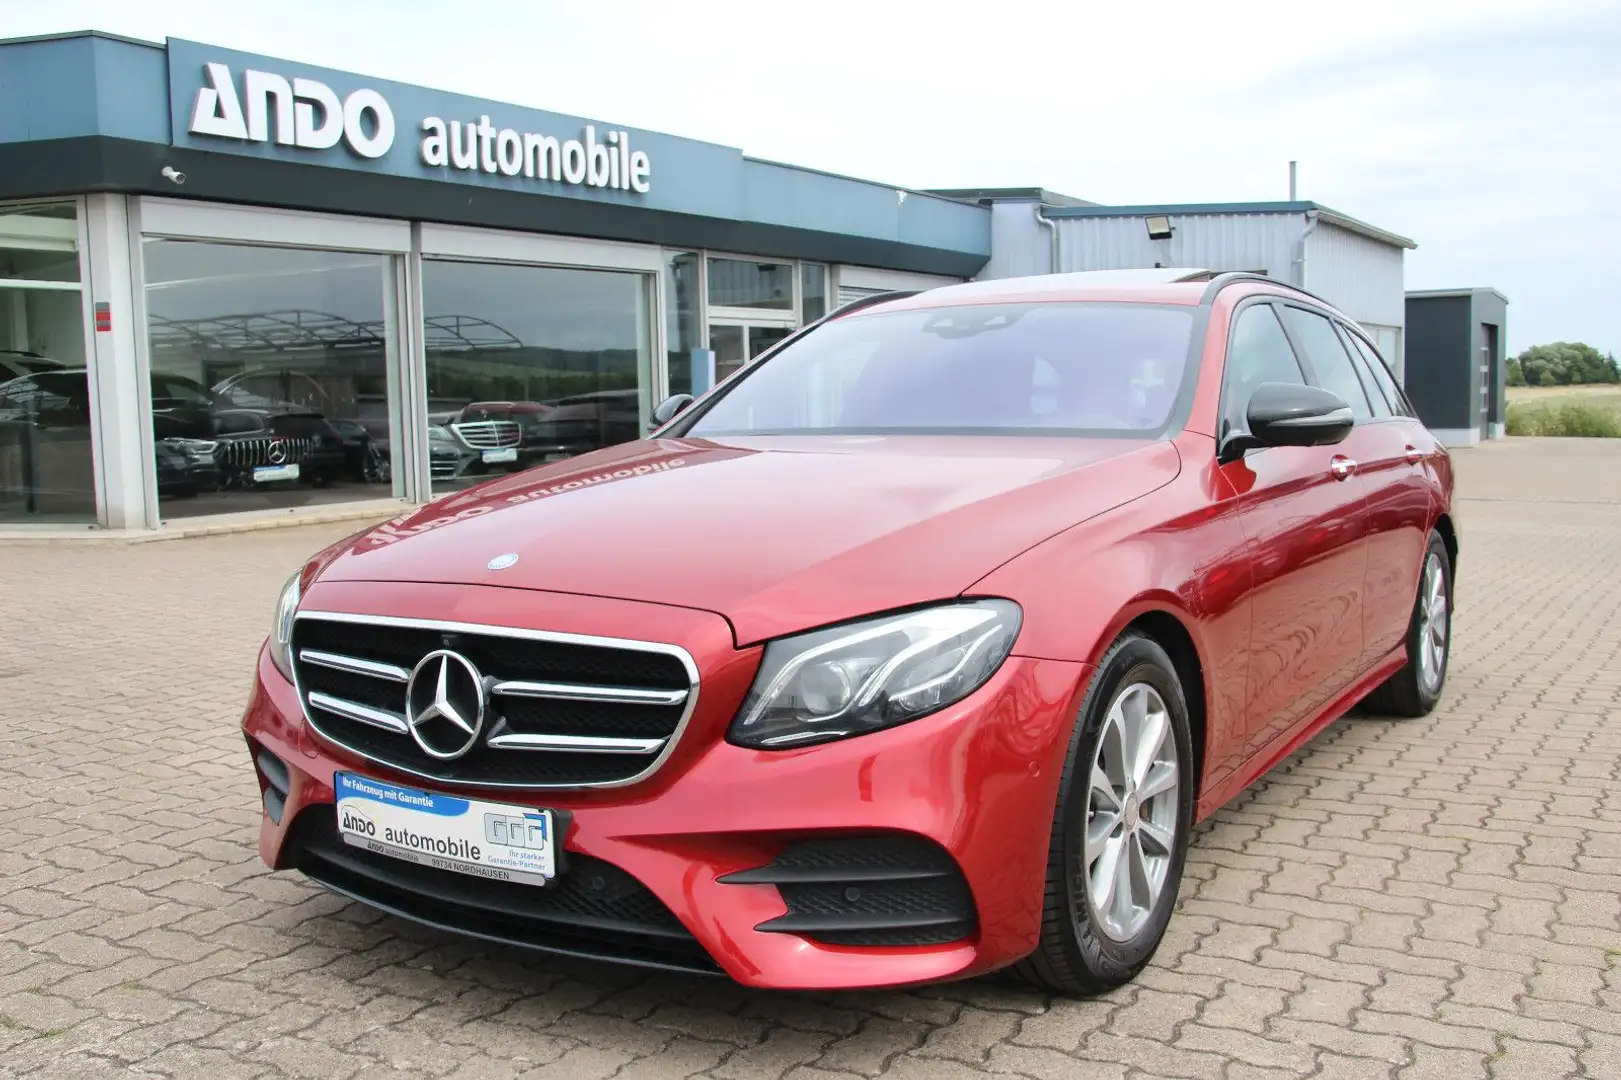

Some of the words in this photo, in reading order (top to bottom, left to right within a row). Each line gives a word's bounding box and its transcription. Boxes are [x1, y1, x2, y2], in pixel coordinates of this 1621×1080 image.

[189, 62, 395, 159] ANDO
[420, 114, 650, 194] automobile
[342, 775, 352, 788] Ihr
[352, 779, 384, 799] Fahrzeug
[384, 789, 397, 800] mit
[398, 792, 434, 808] Garantie
[343, 812, 376, 836] ANDO
[385, 826, 481, 861] automobile
[432, 858, 452, 870] 99734
[453, 863, 510, 880] NORDHAUSEN
[487, 855, 546, 871] Garantie-Partner
